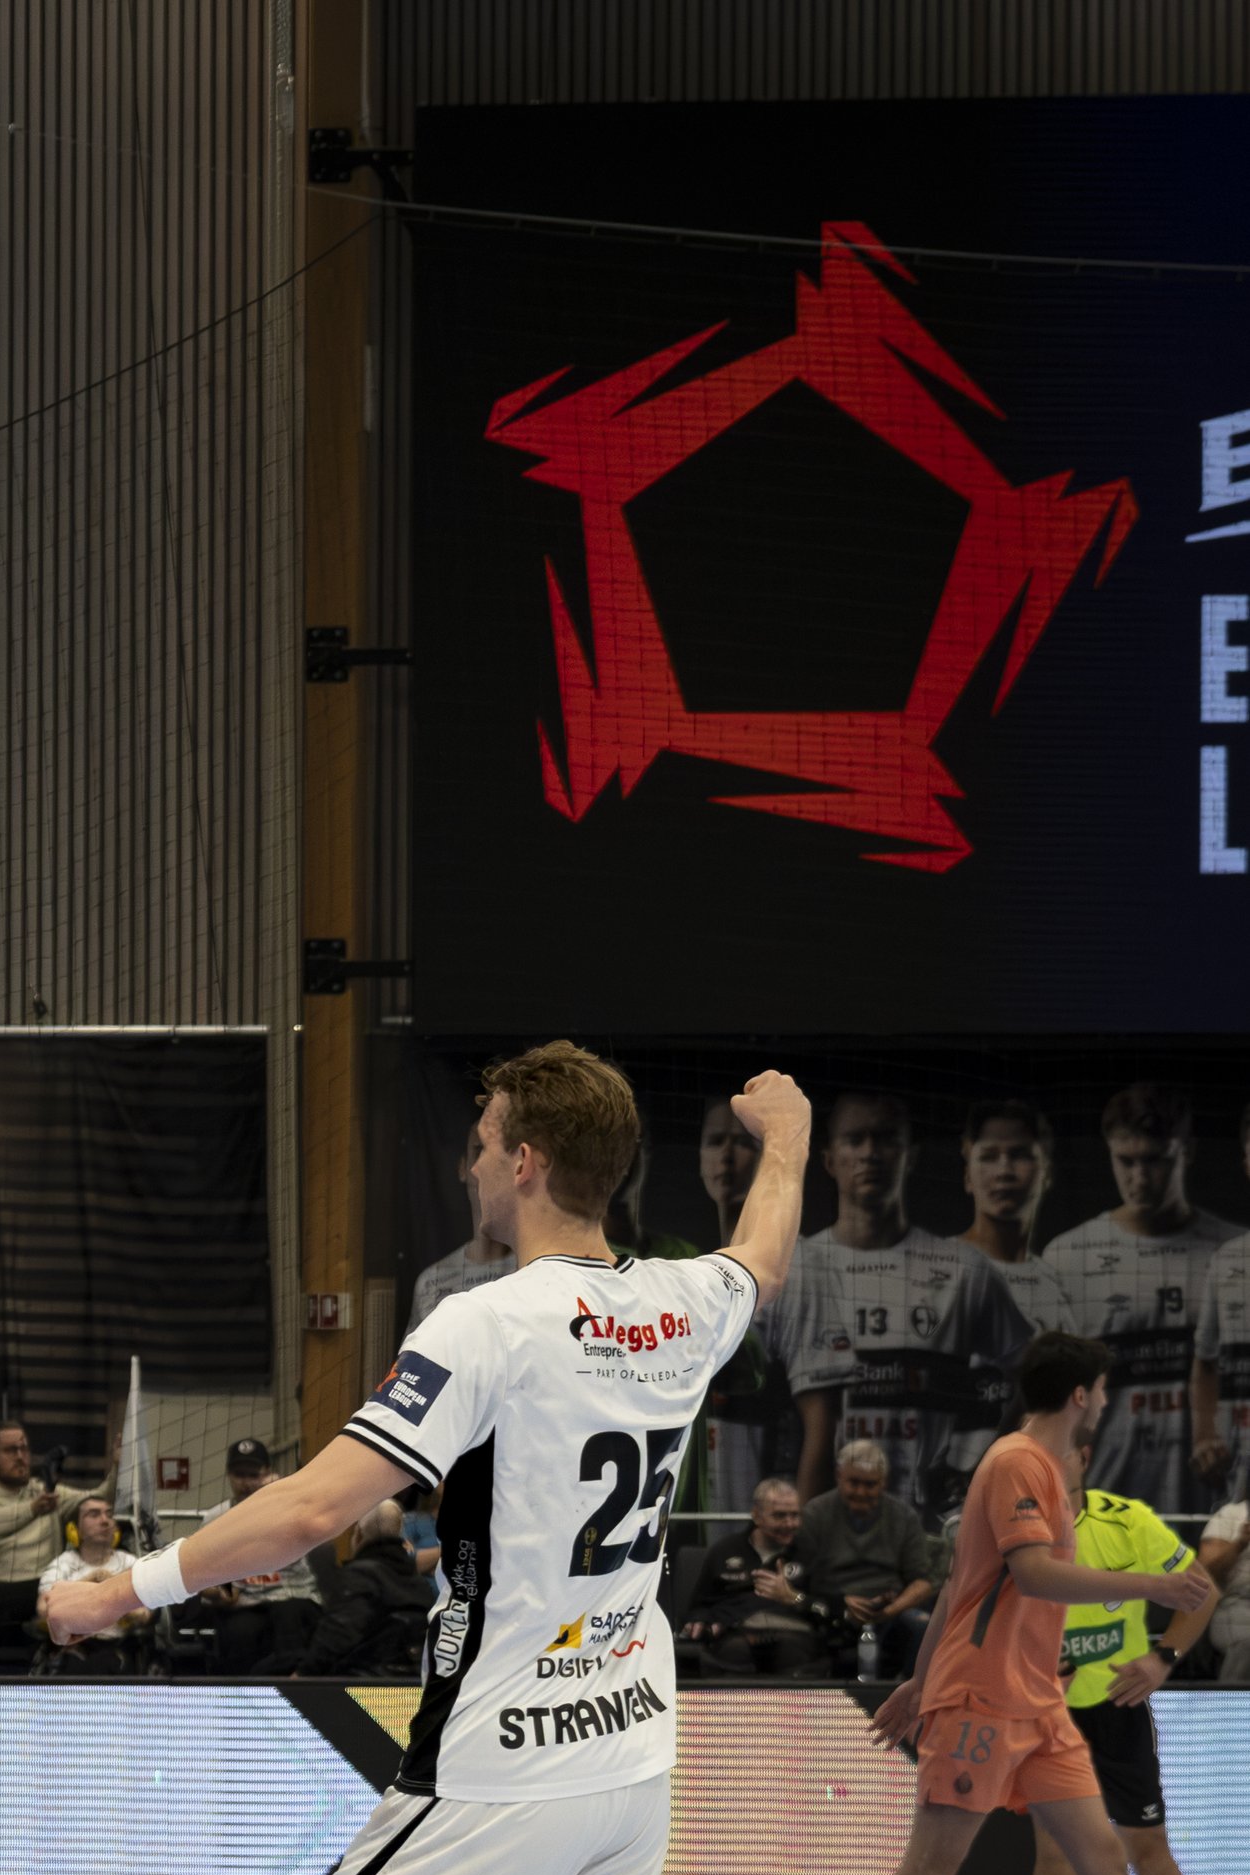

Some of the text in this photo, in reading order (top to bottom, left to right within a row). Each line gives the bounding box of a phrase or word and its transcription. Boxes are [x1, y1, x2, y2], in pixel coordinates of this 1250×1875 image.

[856, 1308, 888, 1335] 13
[597, 1369, 615, 1378] PART
[620, 1369, 635, 1379] OF
[388, 1389, 413, 1408] LEAGUE
[393, 1381, 427, 1406] EUROPEAN
[568, 1426, 688, 1578] 25
[951, 1720, 997, 1764] 18
